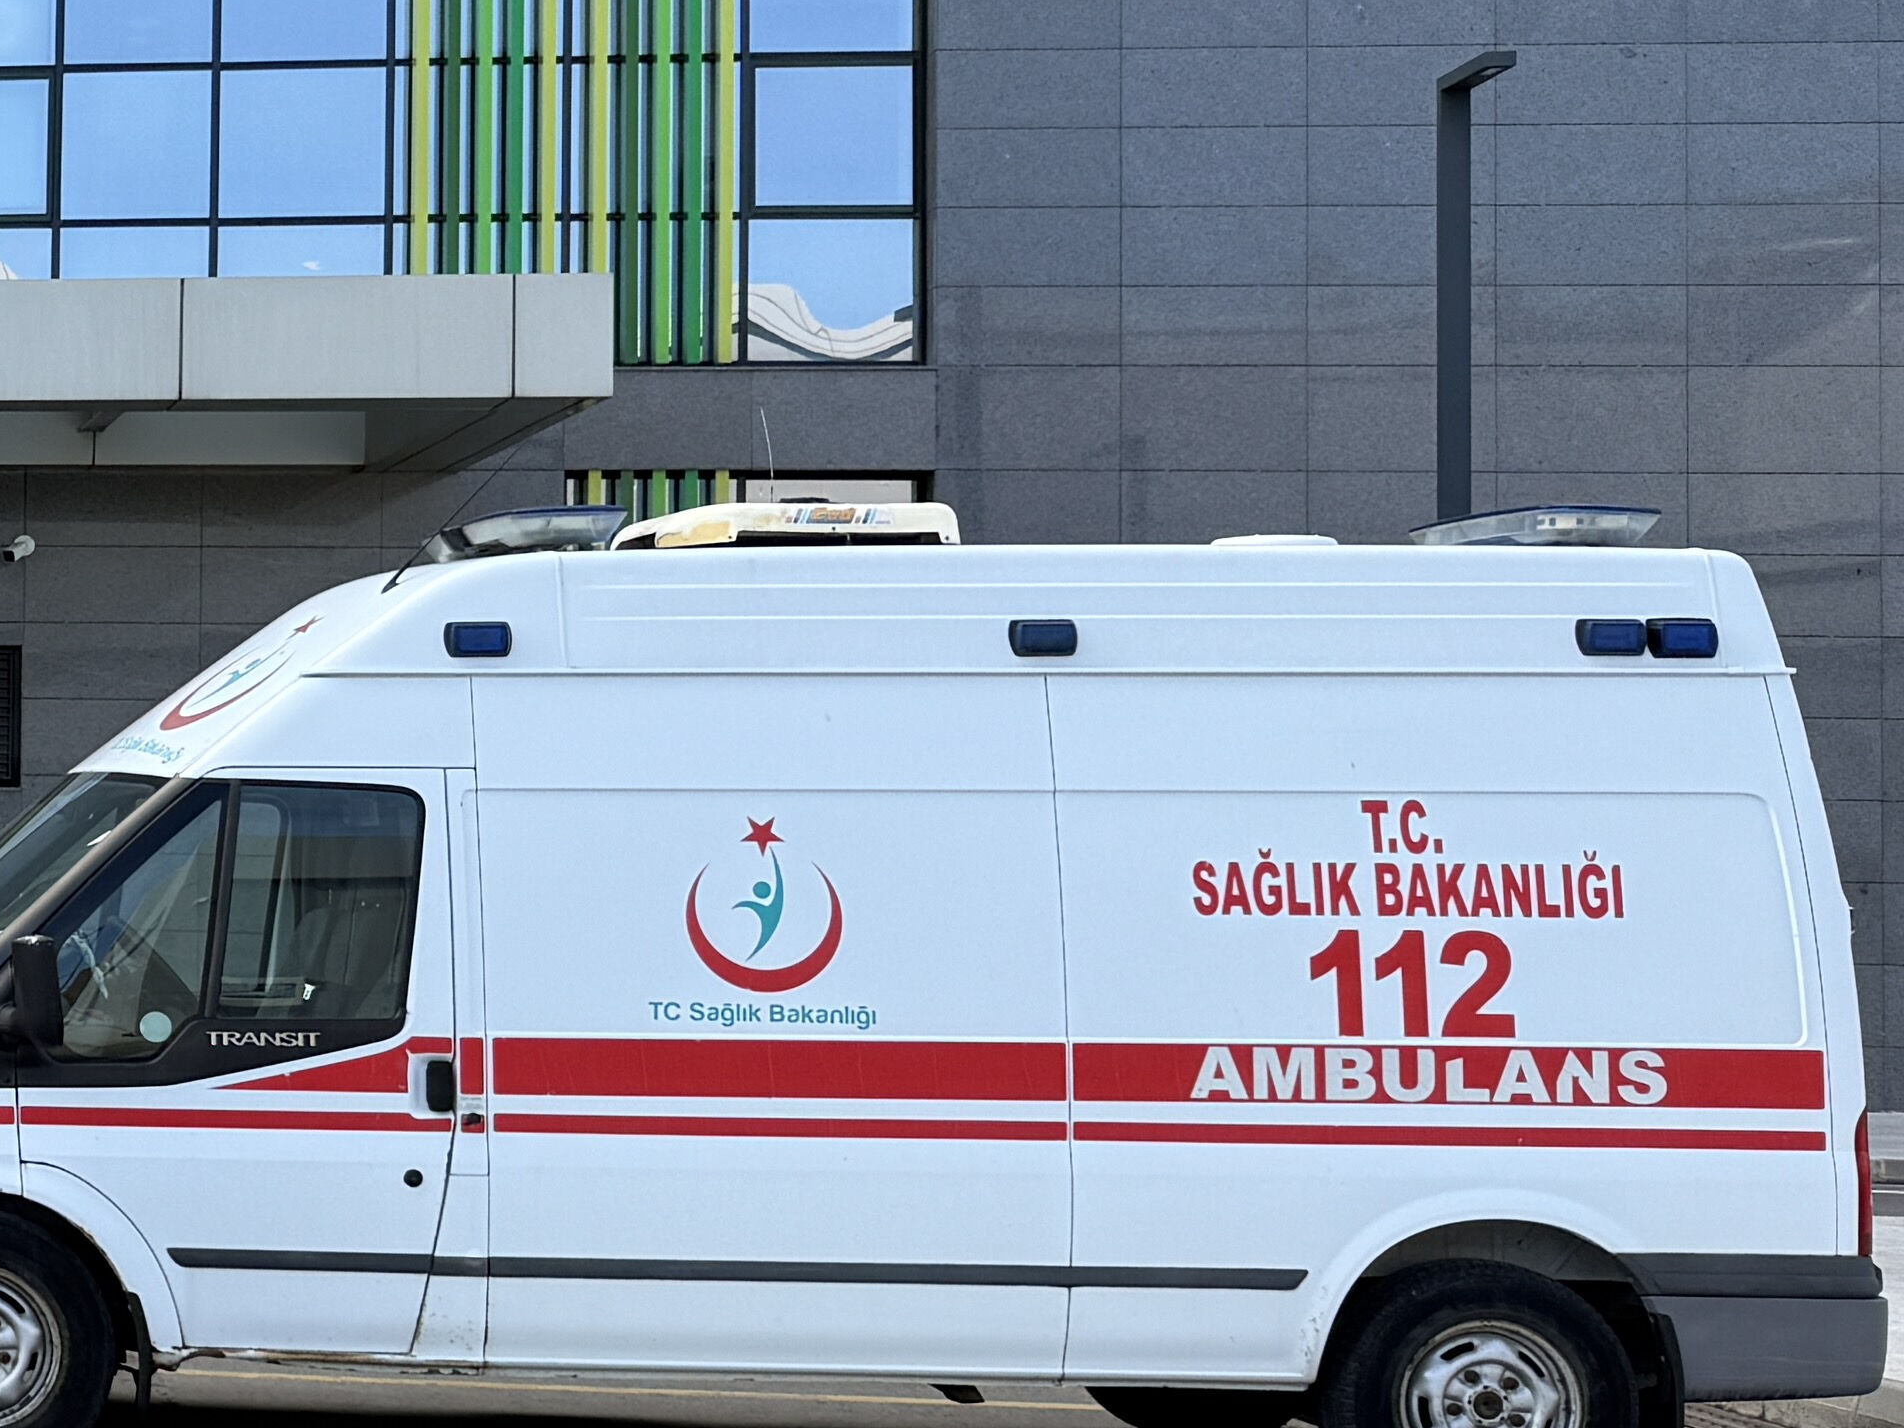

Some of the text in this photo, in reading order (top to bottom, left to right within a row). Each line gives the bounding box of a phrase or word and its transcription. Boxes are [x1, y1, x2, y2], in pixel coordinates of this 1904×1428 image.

[1360, 799, 1444, 855] T.C.
[1191, 847, 1625, 919] SAĞLIK BAKANLIĞI
[1308, 928, 1517, 1039] 112
[205, 1031, 321, 1047] TRANSIT
[648, 1001, 877, 1030] TC Sağlık Bakanlığı
[1190, 1044, 1668, 1105] AMBULANS
